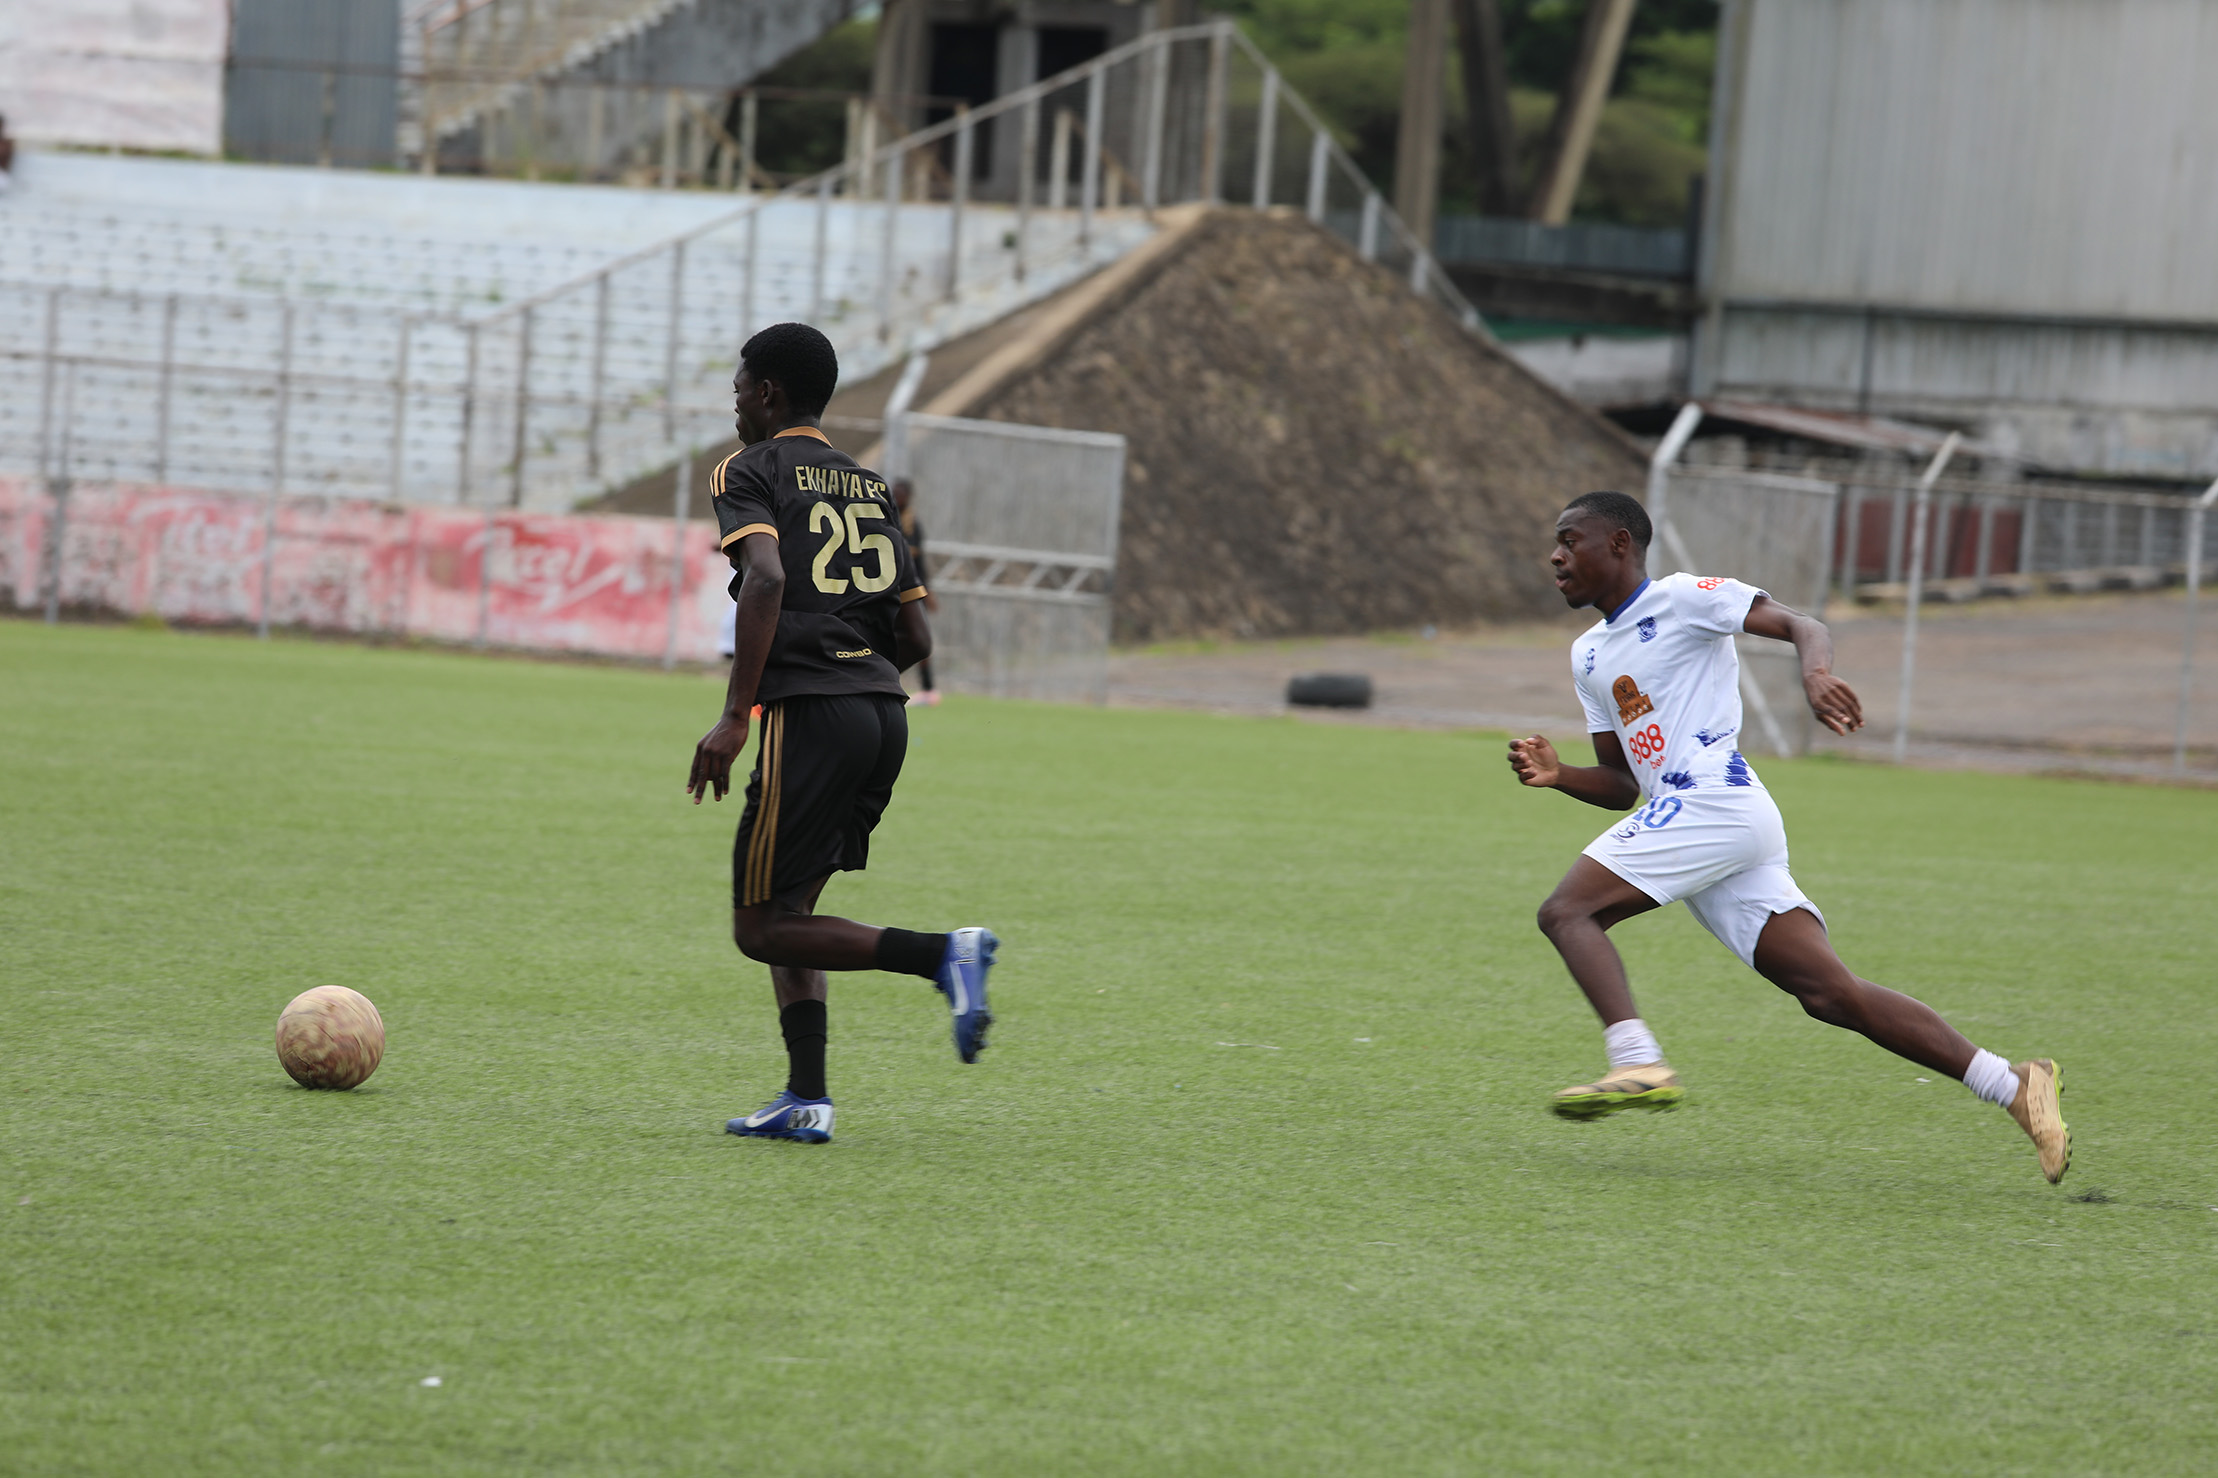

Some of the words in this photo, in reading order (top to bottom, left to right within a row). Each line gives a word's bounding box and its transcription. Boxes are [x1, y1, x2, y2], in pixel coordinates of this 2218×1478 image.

[795, 466, 864, 499] EKHAYA
[809, 501, 897, 595] 25
[1628, 723, 1665, 765] 888
